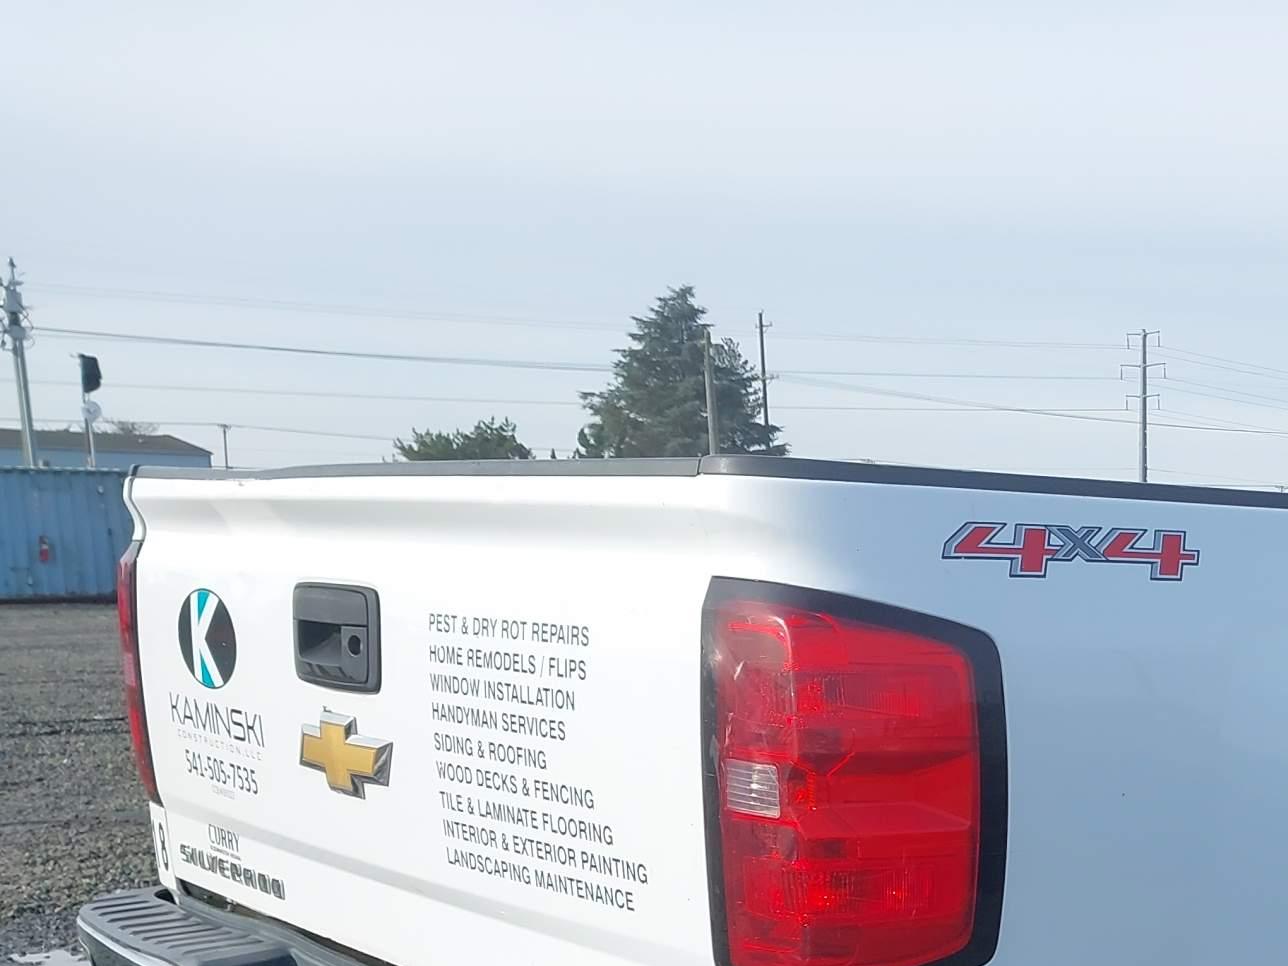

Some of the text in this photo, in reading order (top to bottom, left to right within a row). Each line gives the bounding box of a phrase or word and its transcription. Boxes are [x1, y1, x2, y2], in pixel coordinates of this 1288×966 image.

[428, 612, 590, 647] PEST & DRY ROT REPAIRS
[429, 644, 587, 681] HOME REMODELS / FLIPS
[430, 672, 575, 711] WINDOW INSTALLATION
[169, 691, 265, 748] KAMINSKI
[431, 702, 566, 741] HANDYMAN SERVICES
[185, 748, 258, 795] 541-505-7535
[433, 732, 547, 770] SIDING & ROOFING
[436, 760, 594, 810] WOOD DECKS & FENCING
[208, 823, 240, 853] CURRY
[439, 791, 614, 846] TILE & LAMINATE FLOORING
[443, 819, 648, 885] INTERIOR & EXTERIOR PAINTING
[446, 846, 635, 912] LANDSCAPING MAINTENANCE
